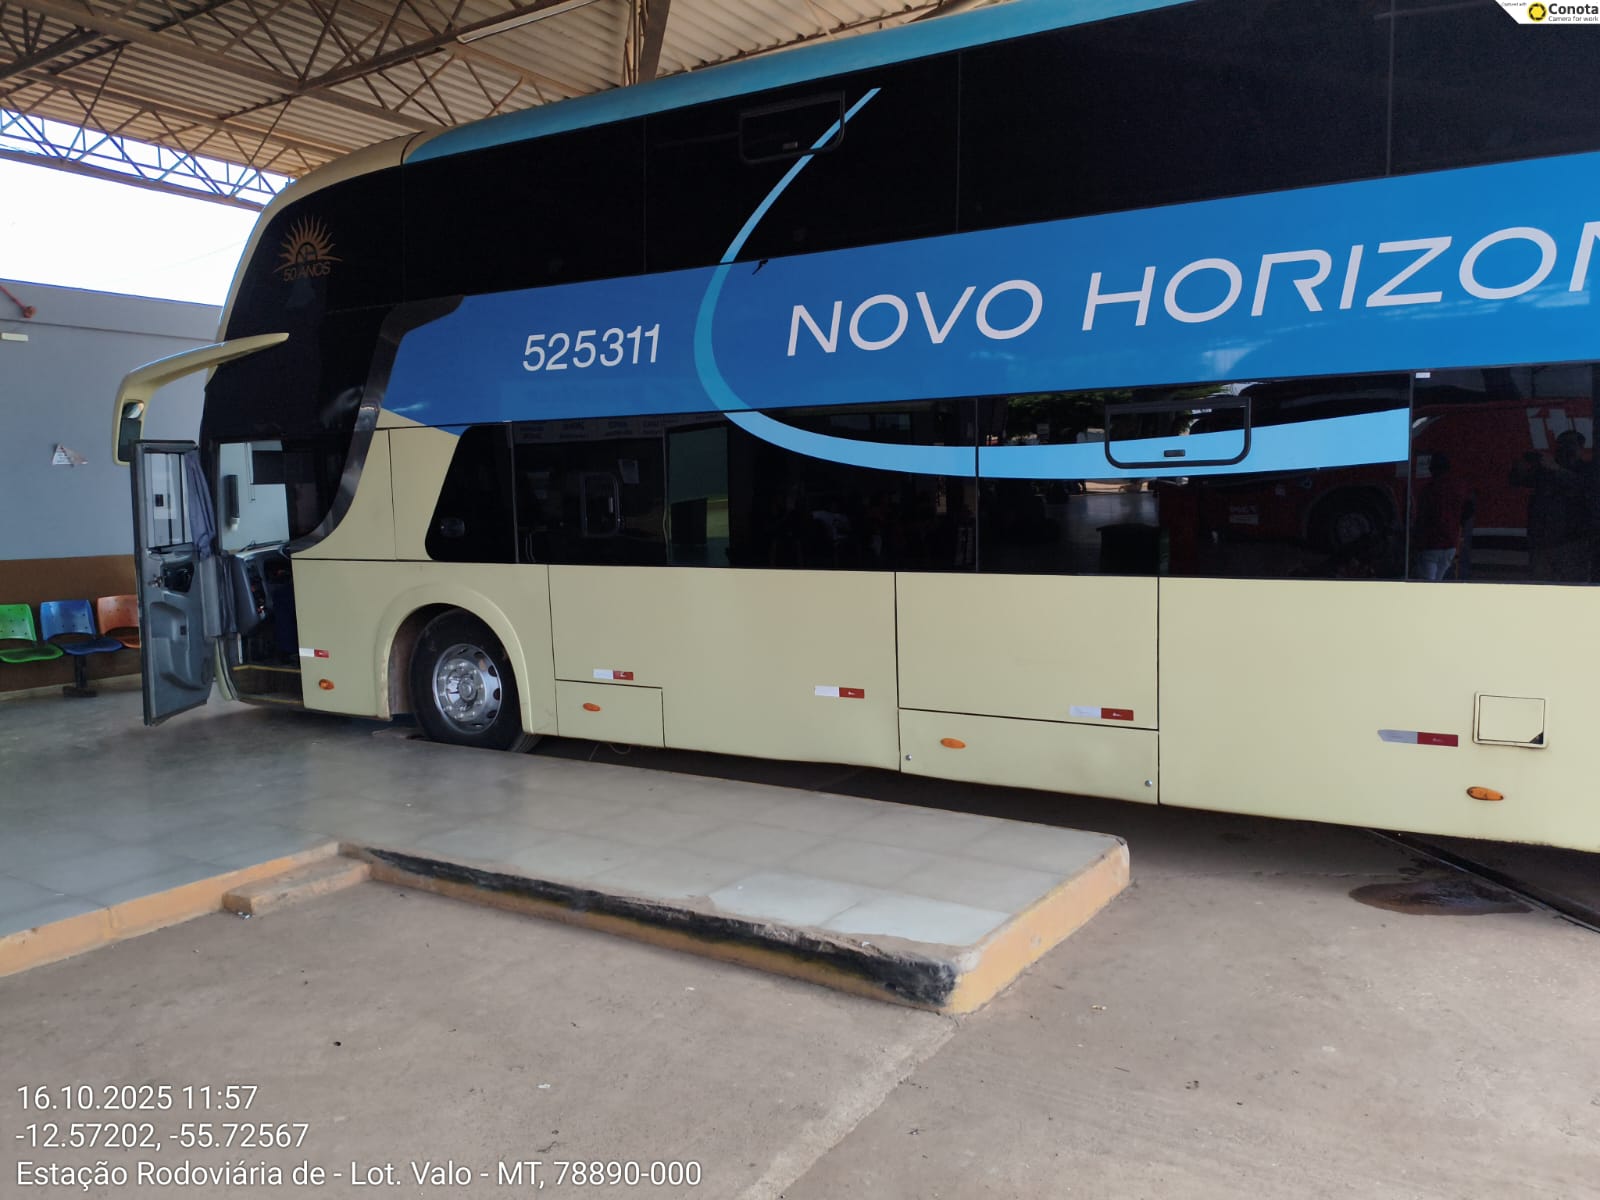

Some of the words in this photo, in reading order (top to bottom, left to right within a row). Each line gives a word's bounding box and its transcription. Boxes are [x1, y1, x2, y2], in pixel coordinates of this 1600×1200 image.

[297, 262, 331, 279] ANOS
[787, 278, 1044, 357] NOVO
[522, 323, 660, 372] 525311
